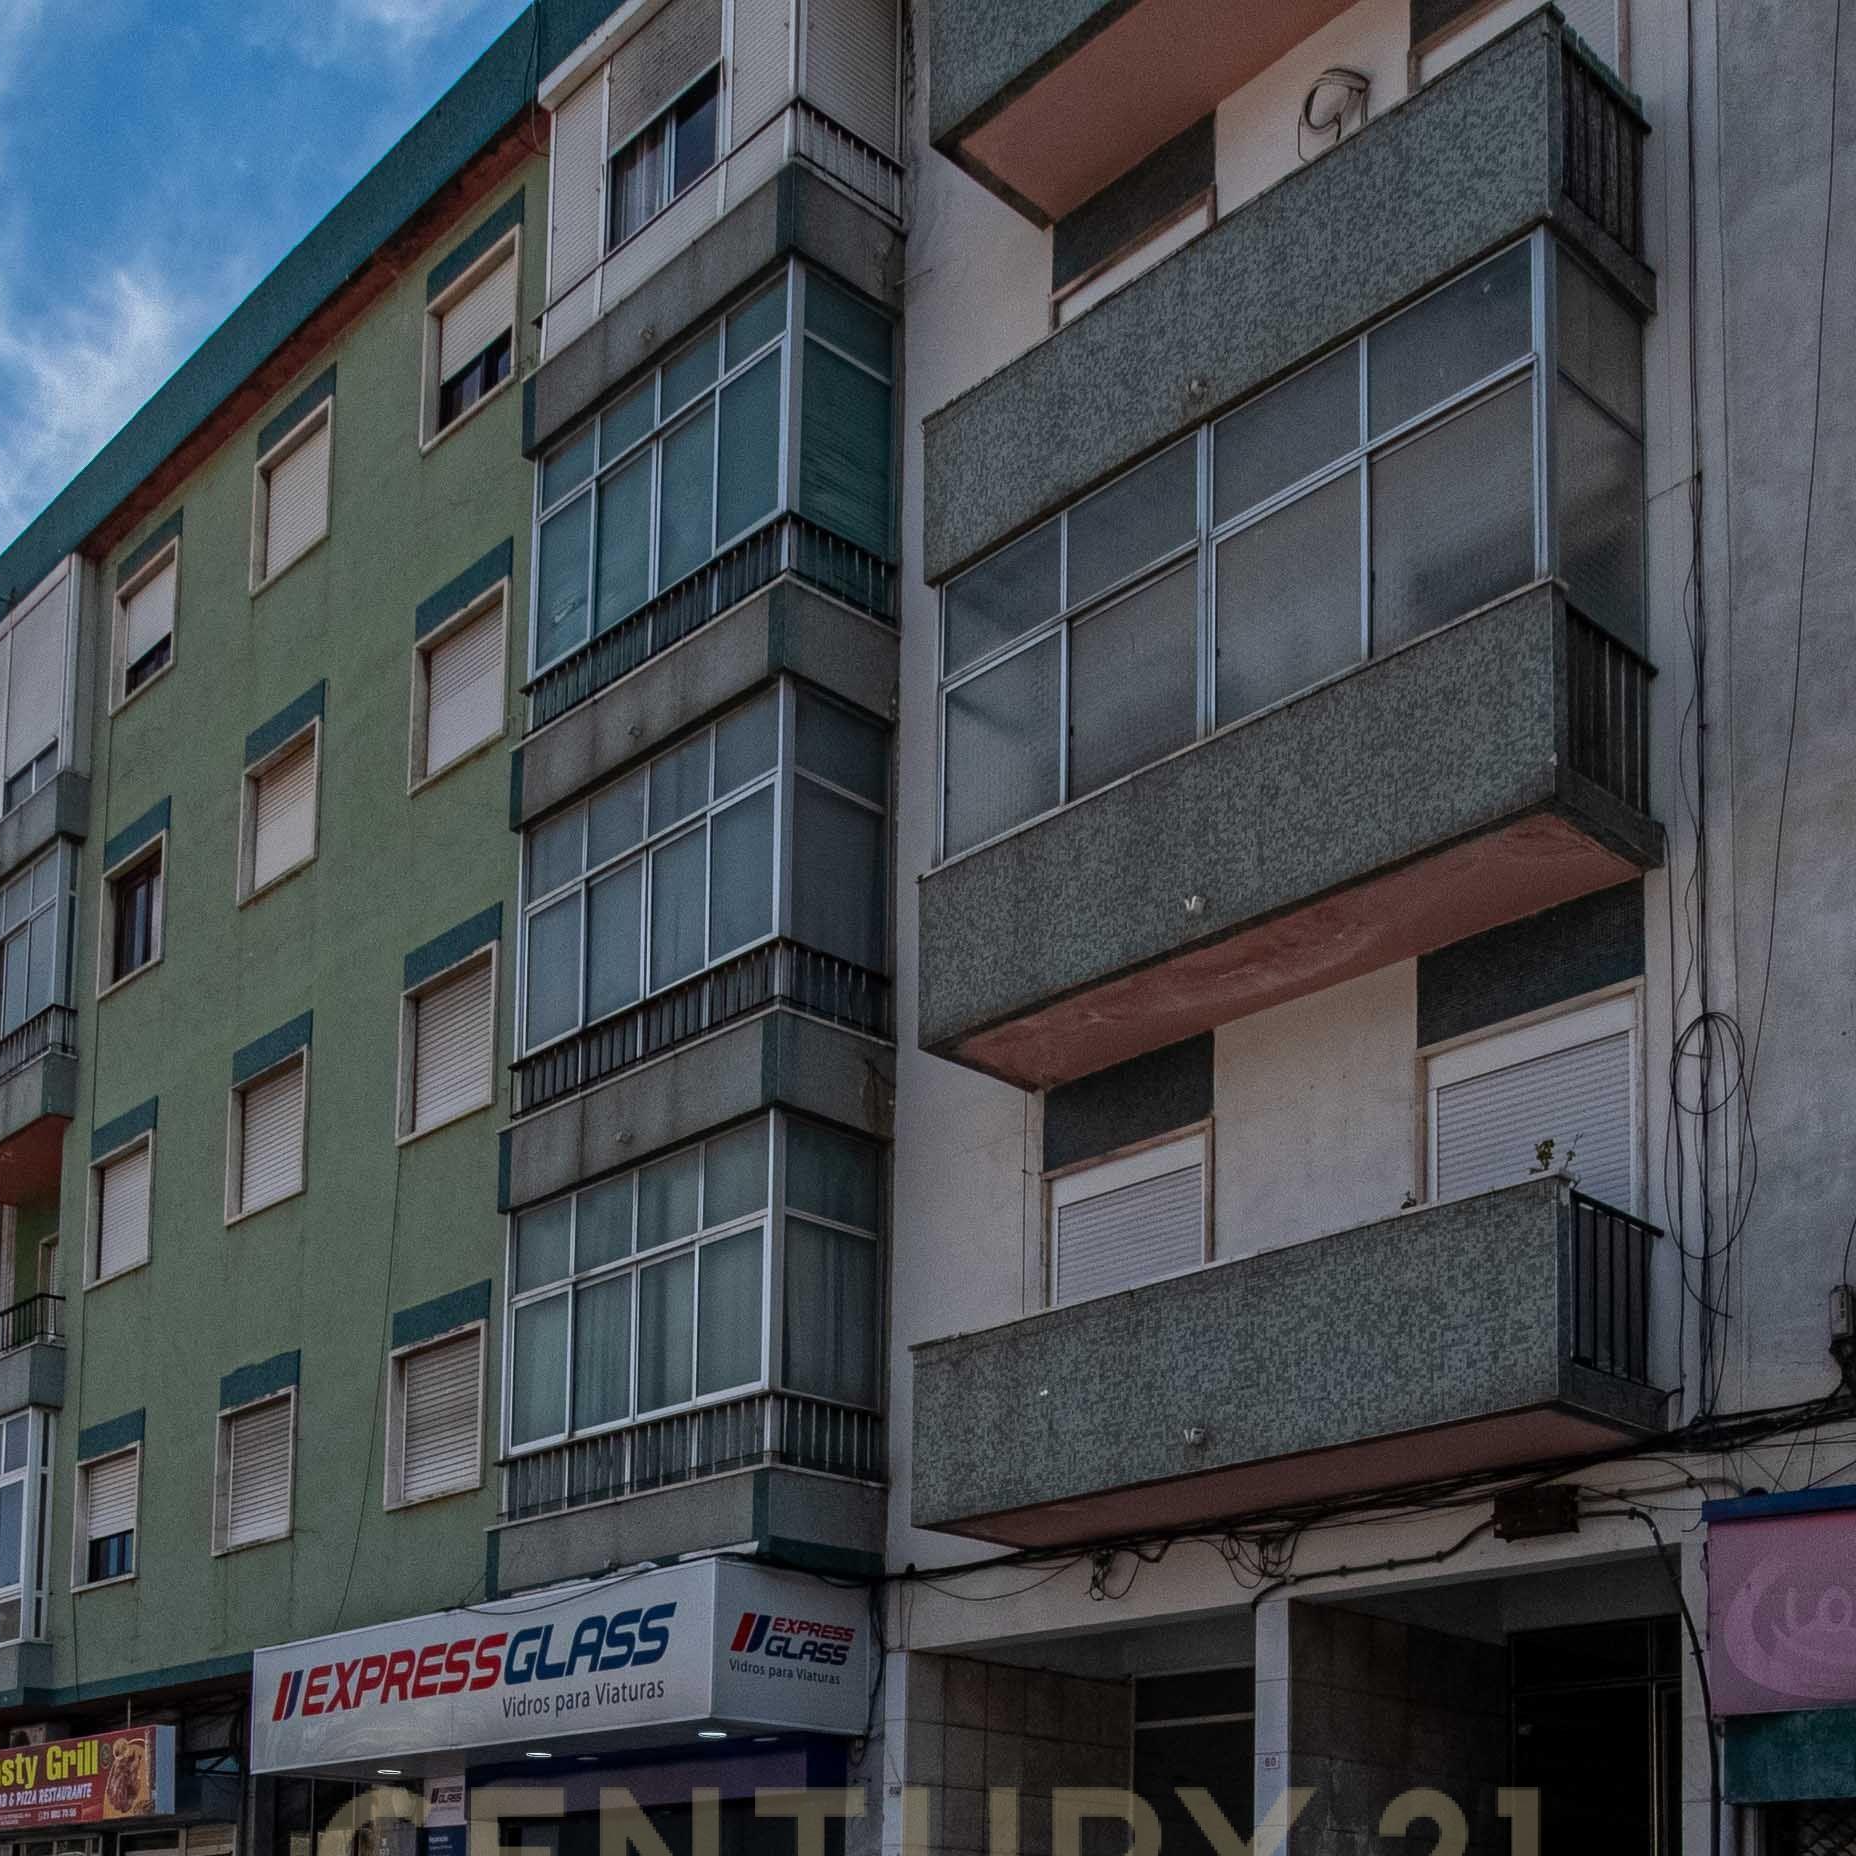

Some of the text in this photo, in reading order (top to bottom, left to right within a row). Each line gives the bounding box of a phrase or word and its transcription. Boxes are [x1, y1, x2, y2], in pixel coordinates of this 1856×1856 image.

[772, 1617, 855, 1642] EXPRESS
[765, 1635, 850, 1666] GLASS
[729, 1659, 841, 1685] Vidros para Viaturas
[503, 1679, 665, 1718] Vidros para Viaturas
[46, 1740, 99, 1782] Grill
[16, 1788, 37, 1806] PIZZA
[38, 1782, 93, 1804] RESTAURANTE
